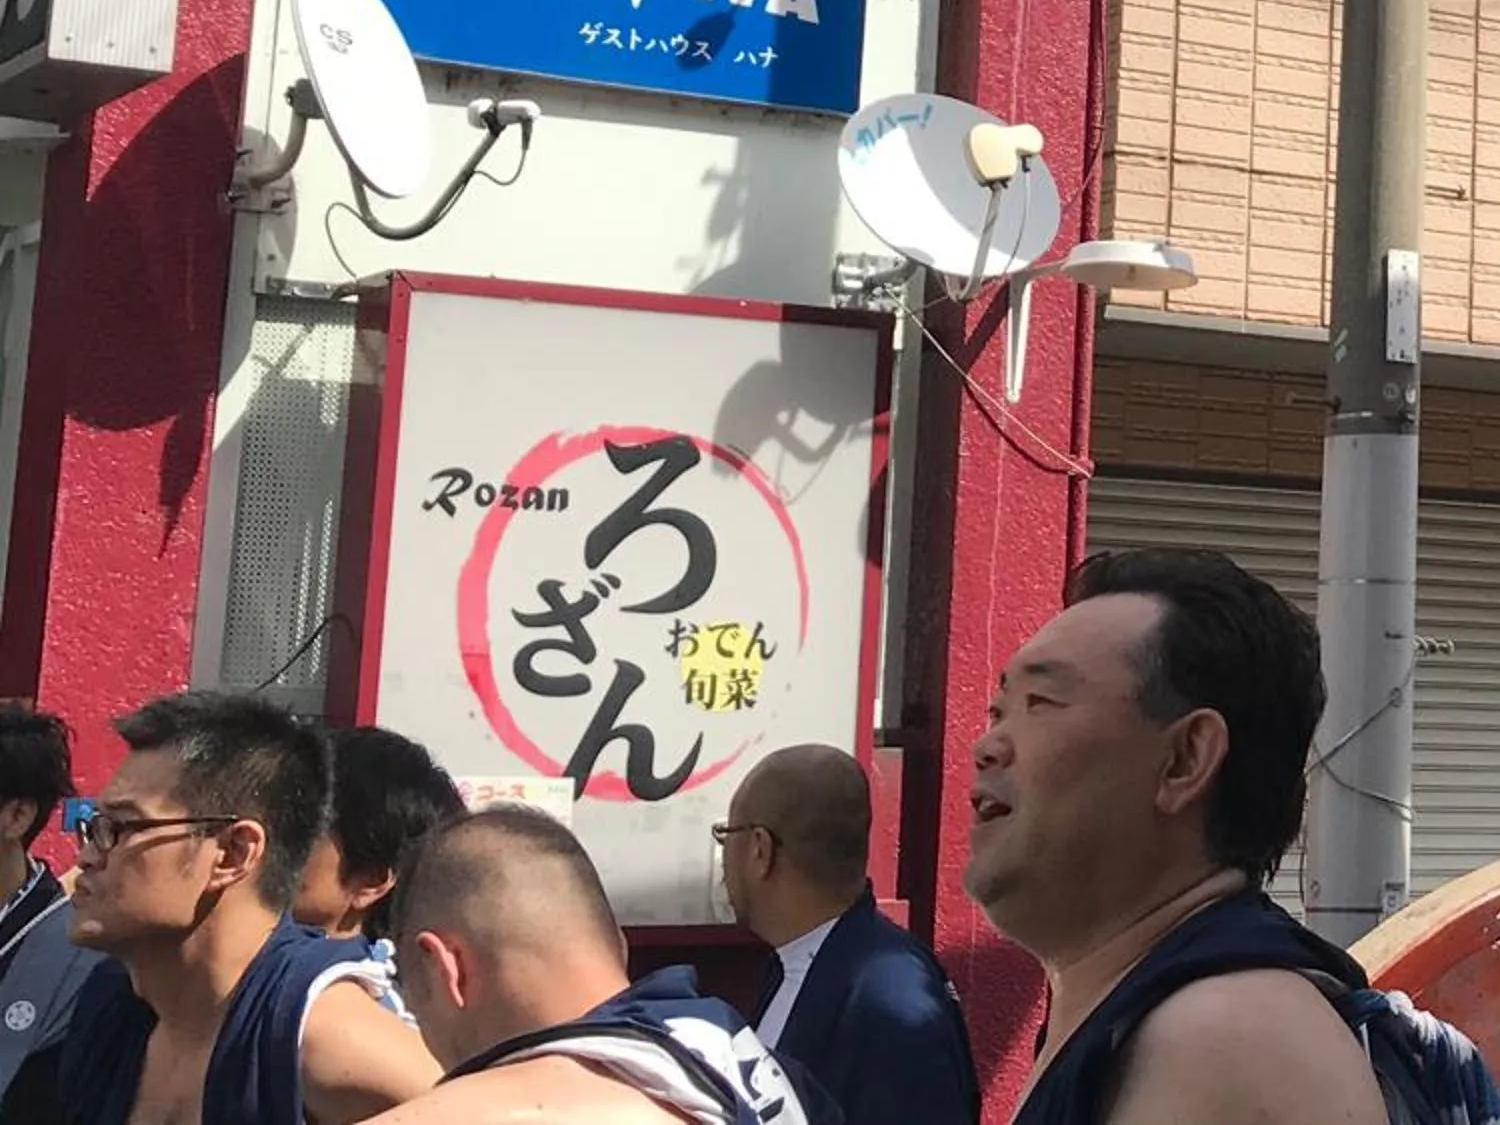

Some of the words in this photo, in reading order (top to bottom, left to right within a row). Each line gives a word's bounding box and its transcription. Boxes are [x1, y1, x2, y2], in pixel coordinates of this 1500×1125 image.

[579, 20, 713, 62] ゲストハウス
[734, 46, 779, 69] ハナ
[420, 466, 570, 517] Rozan
[664, 618, 777, 662] おでん
[682, 667, 760, 711] 旬菜
